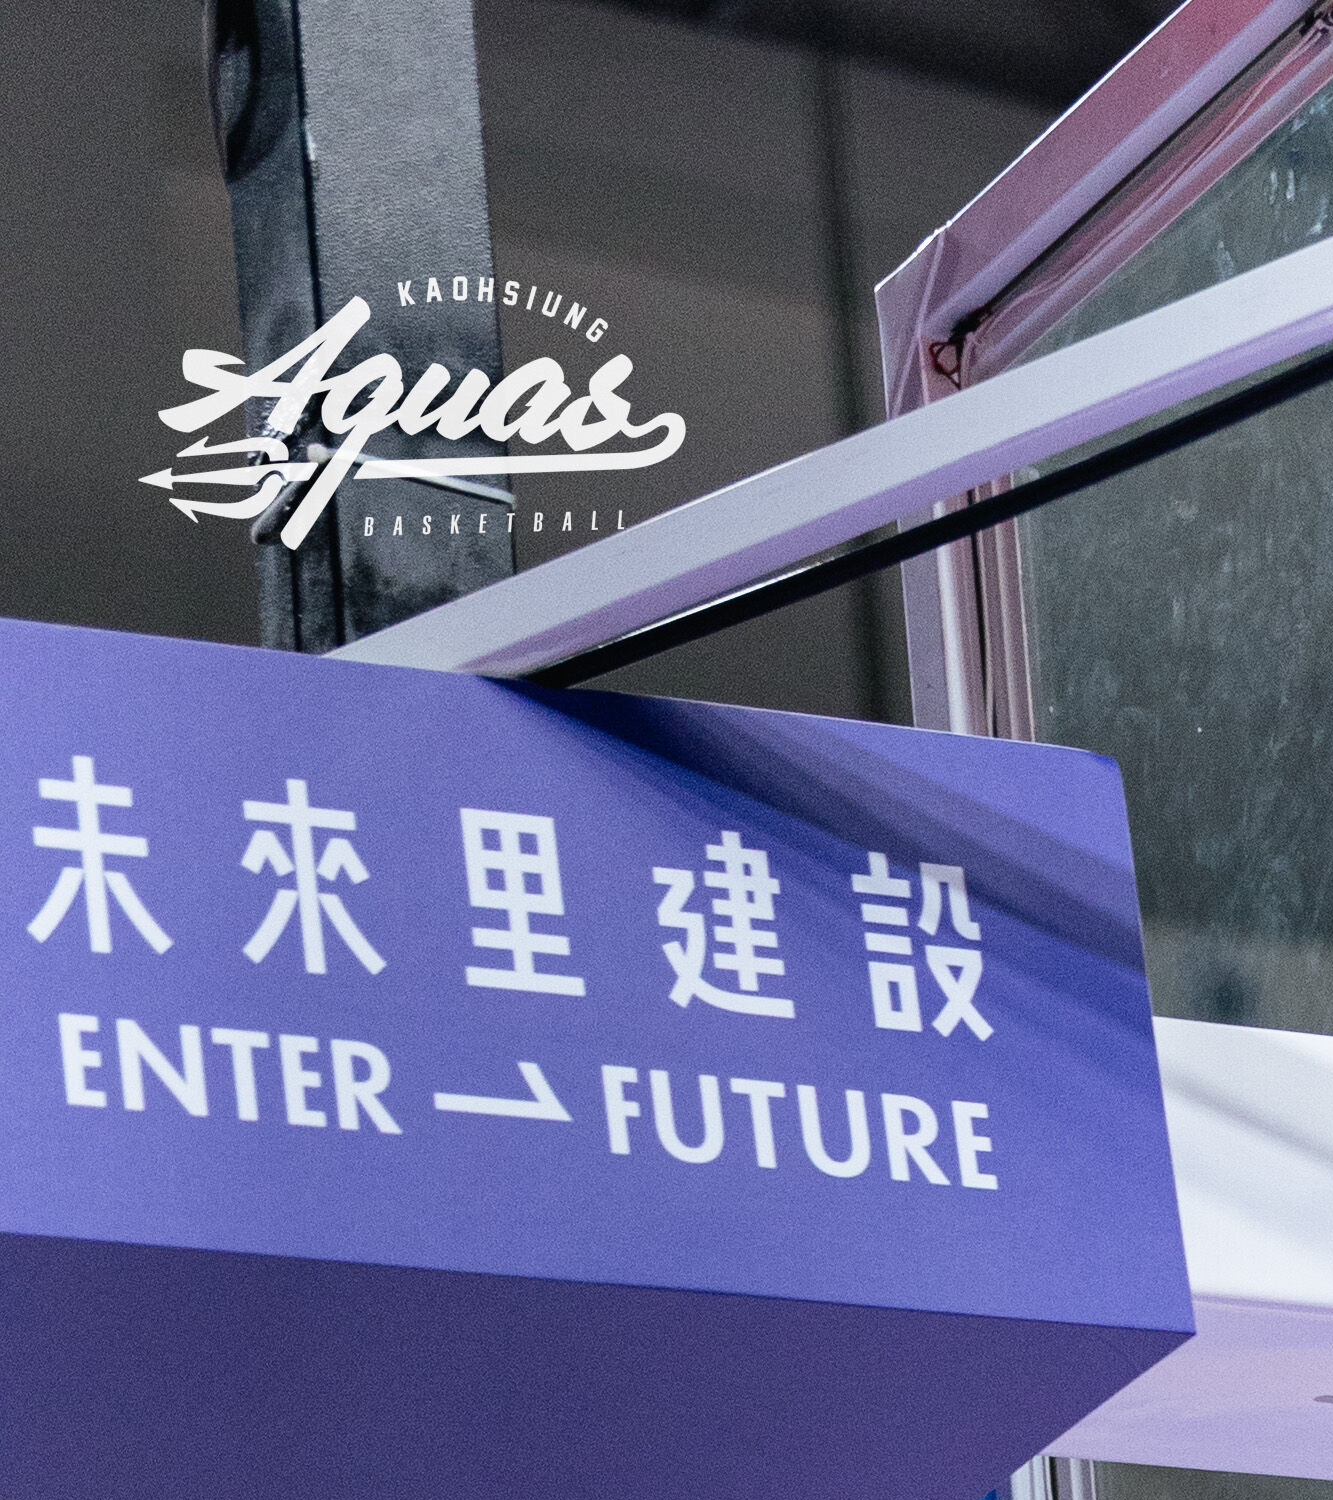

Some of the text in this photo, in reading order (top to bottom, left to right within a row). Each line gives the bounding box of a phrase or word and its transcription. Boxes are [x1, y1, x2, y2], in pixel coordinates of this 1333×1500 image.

[27, 755, 994, 1042] 未來里建設
[58, 1012, 999, 1190] ENTER FUTURE
